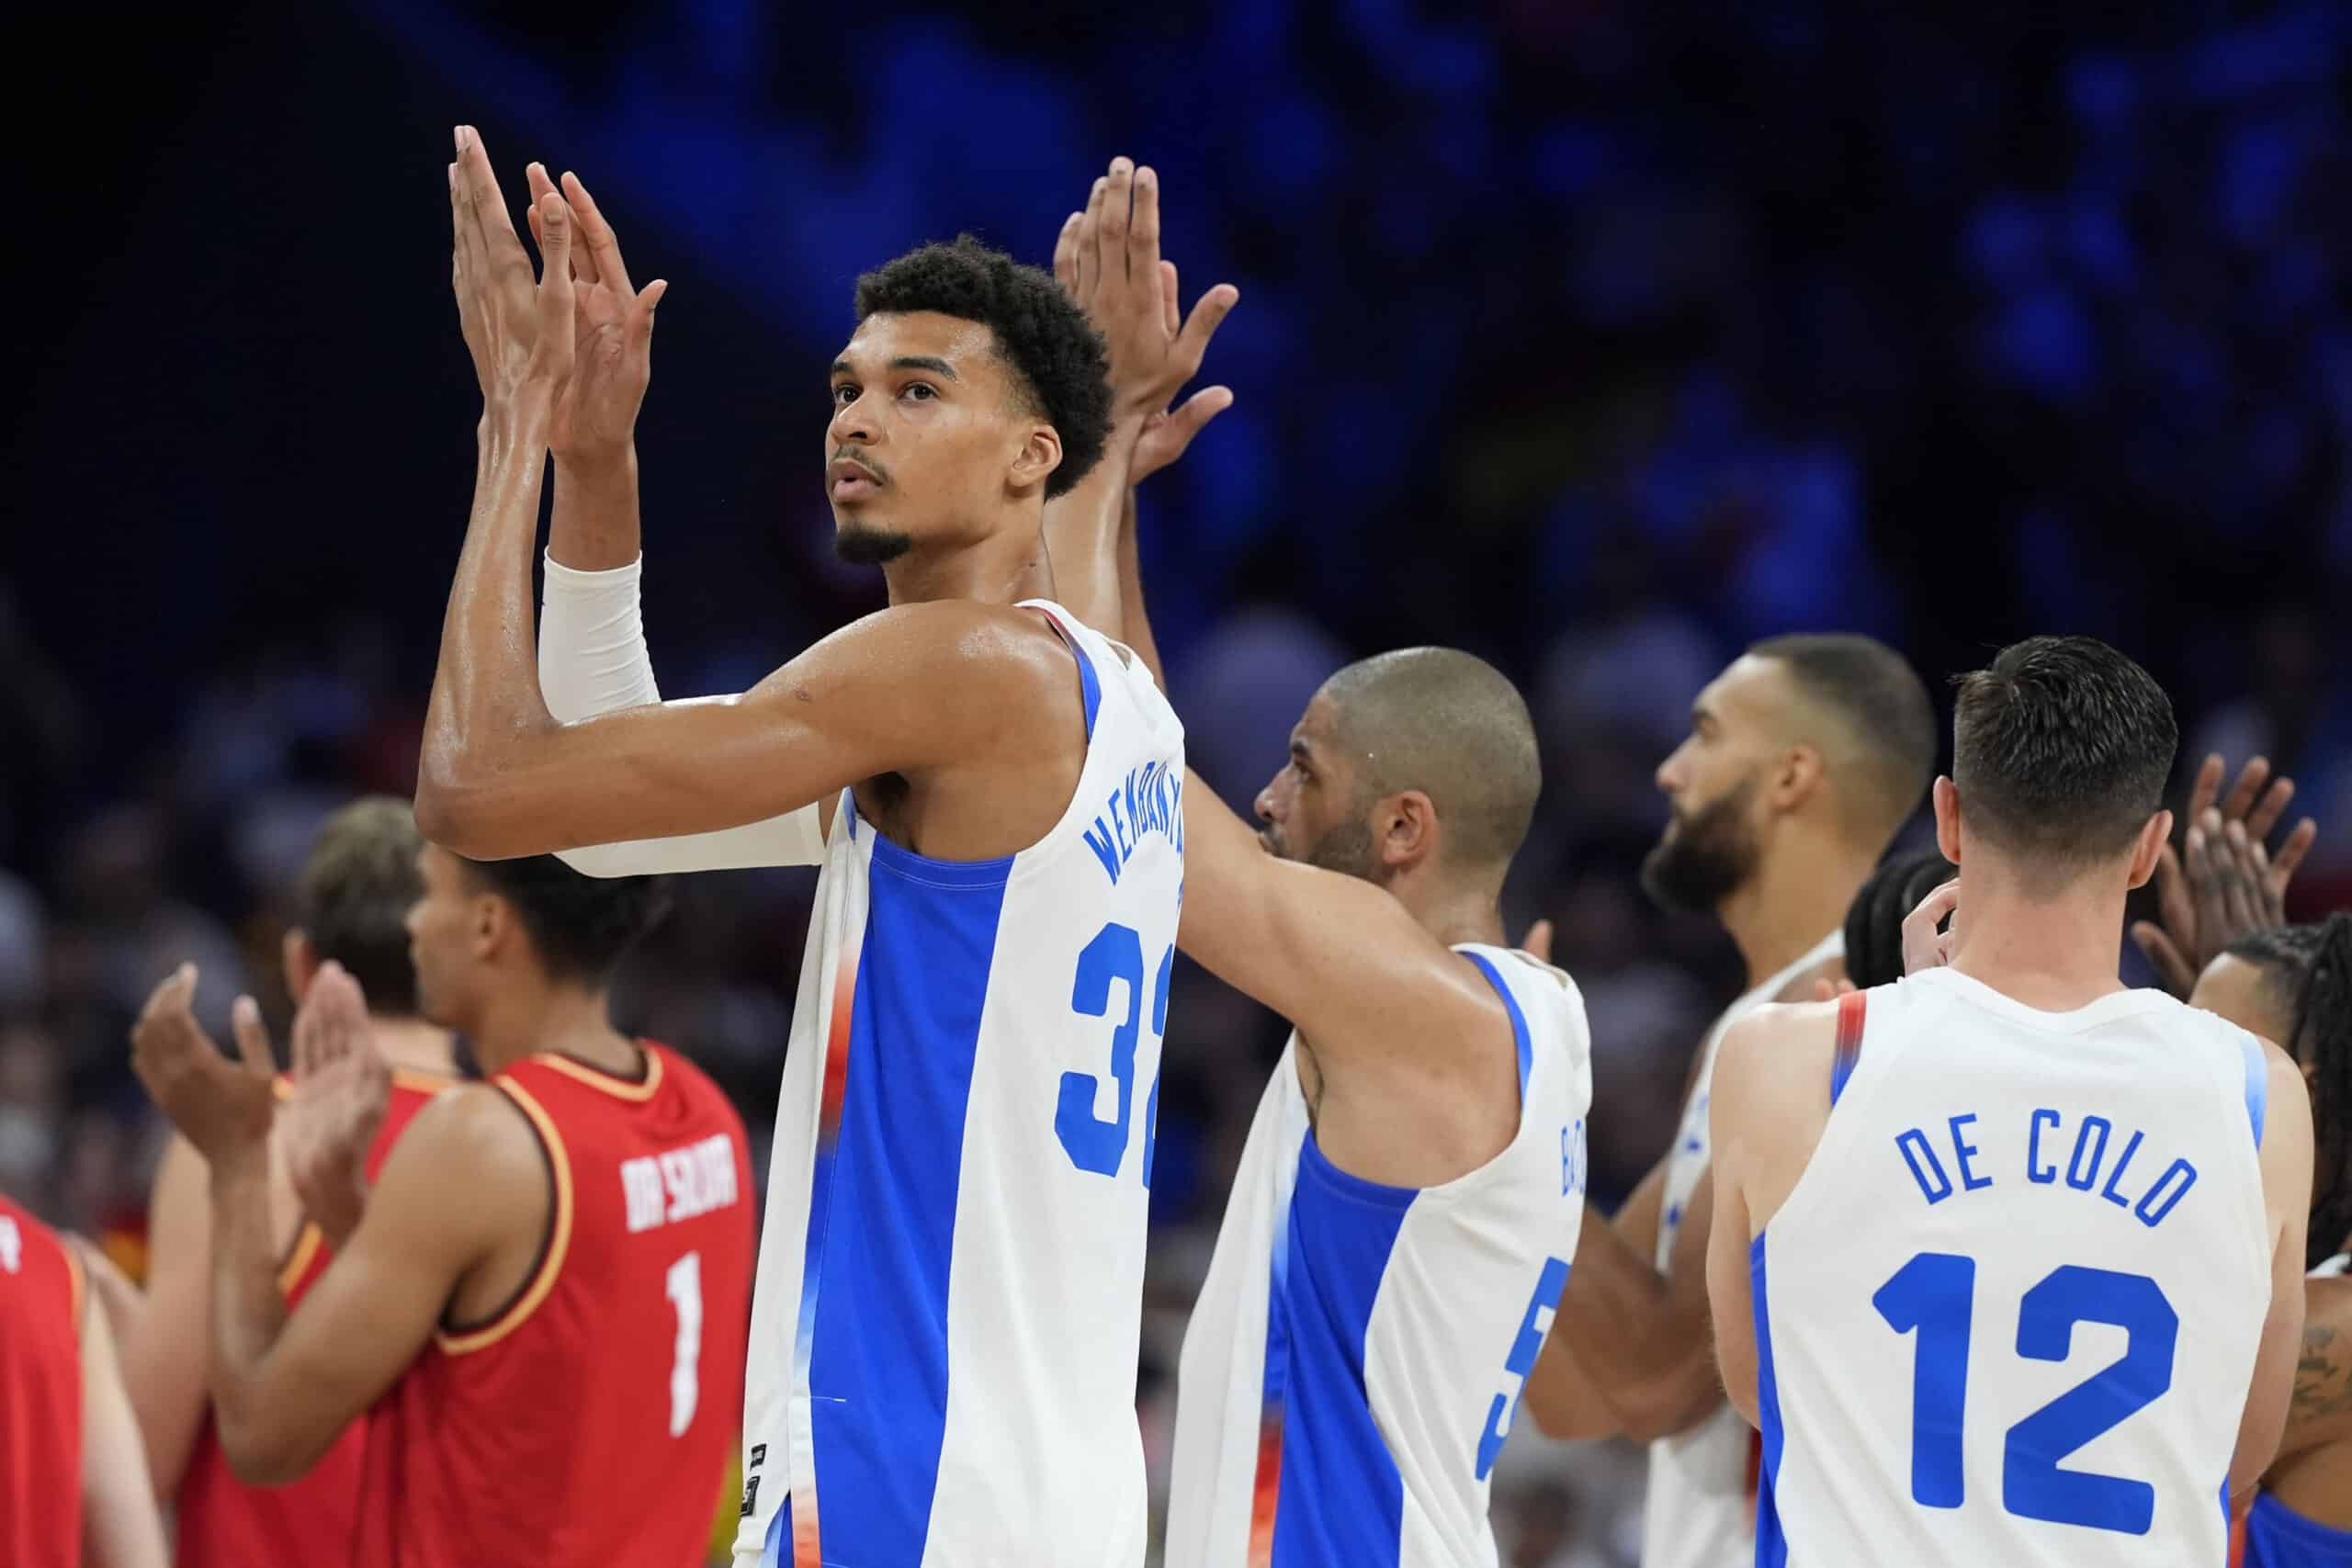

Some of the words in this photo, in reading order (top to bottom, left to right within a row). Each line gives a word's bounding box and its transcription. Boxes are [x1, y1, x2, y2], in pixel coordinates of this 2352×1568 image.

[1894, 1112, 1993, 1205] DE
[2027, 1108, 2198, 1228] COLO
[666, 1250, 703, 1438] 1
[1871, 1252, 2180, 1536] 12
